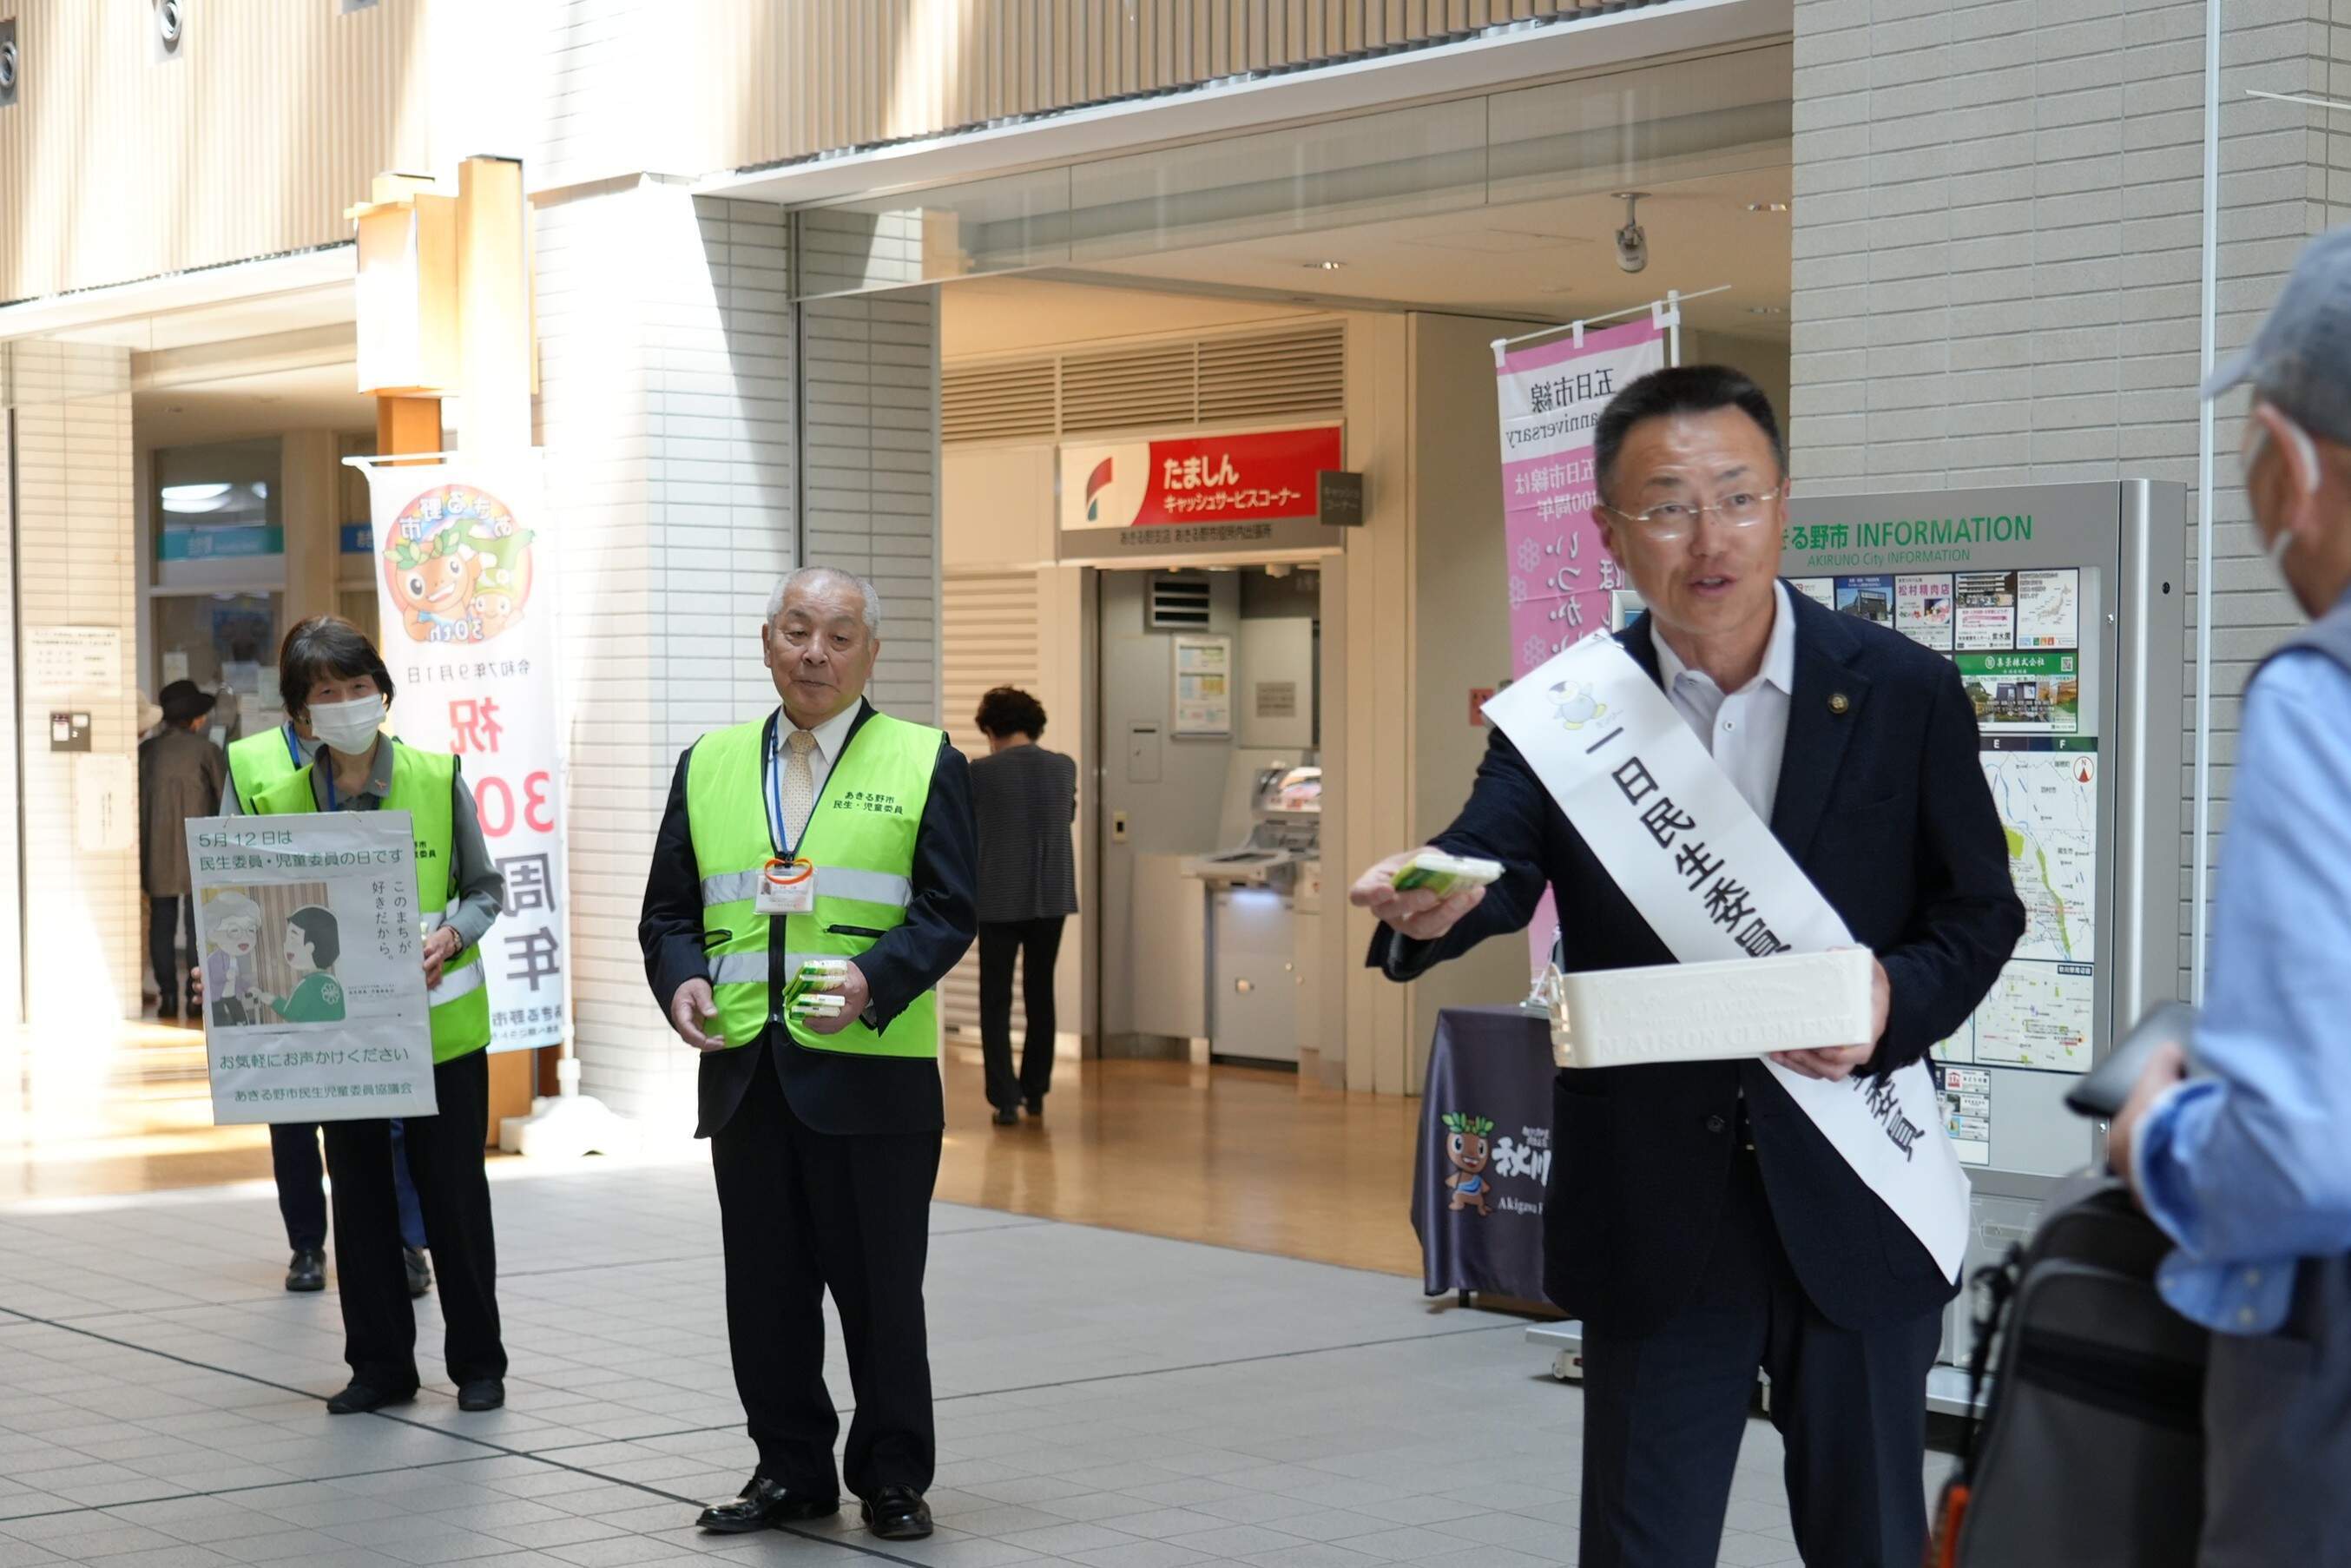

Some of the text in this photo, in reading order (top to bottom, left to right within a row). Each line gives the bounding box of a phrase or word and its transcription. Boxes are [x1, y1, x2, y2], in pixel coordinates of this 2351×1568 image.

[1163, 453, 1240, 490] たましん
[1164, 486, 1301, 514] キャッシュサービスコーナー
[1856, 515, 2032, 548] INFORMATION
[1808, 548, 1971, 567] AKIRUNO City INFORMATION
[1993, 739, 2000, 749] E
[2059, 739, 2066, 749] F
[833, 800, 903, 814] 民生・児童委員
[845, 791, 894, 803] あきる野市
[1586, 727, 1792, 958] 一日民生委員
[200, 848, 403, 872] 民生委員・児童委員の日です
[372, 880, 394, 960] 好きだから。
[393, 880, 412, 954] このまちが
[220, 1047, 410, 1070] お気軽にお声かけください
[234, 1082, 412, 1103] あきる野市民生児童委員協議会
[1492, 1136, 1552, 1187] 秋川
